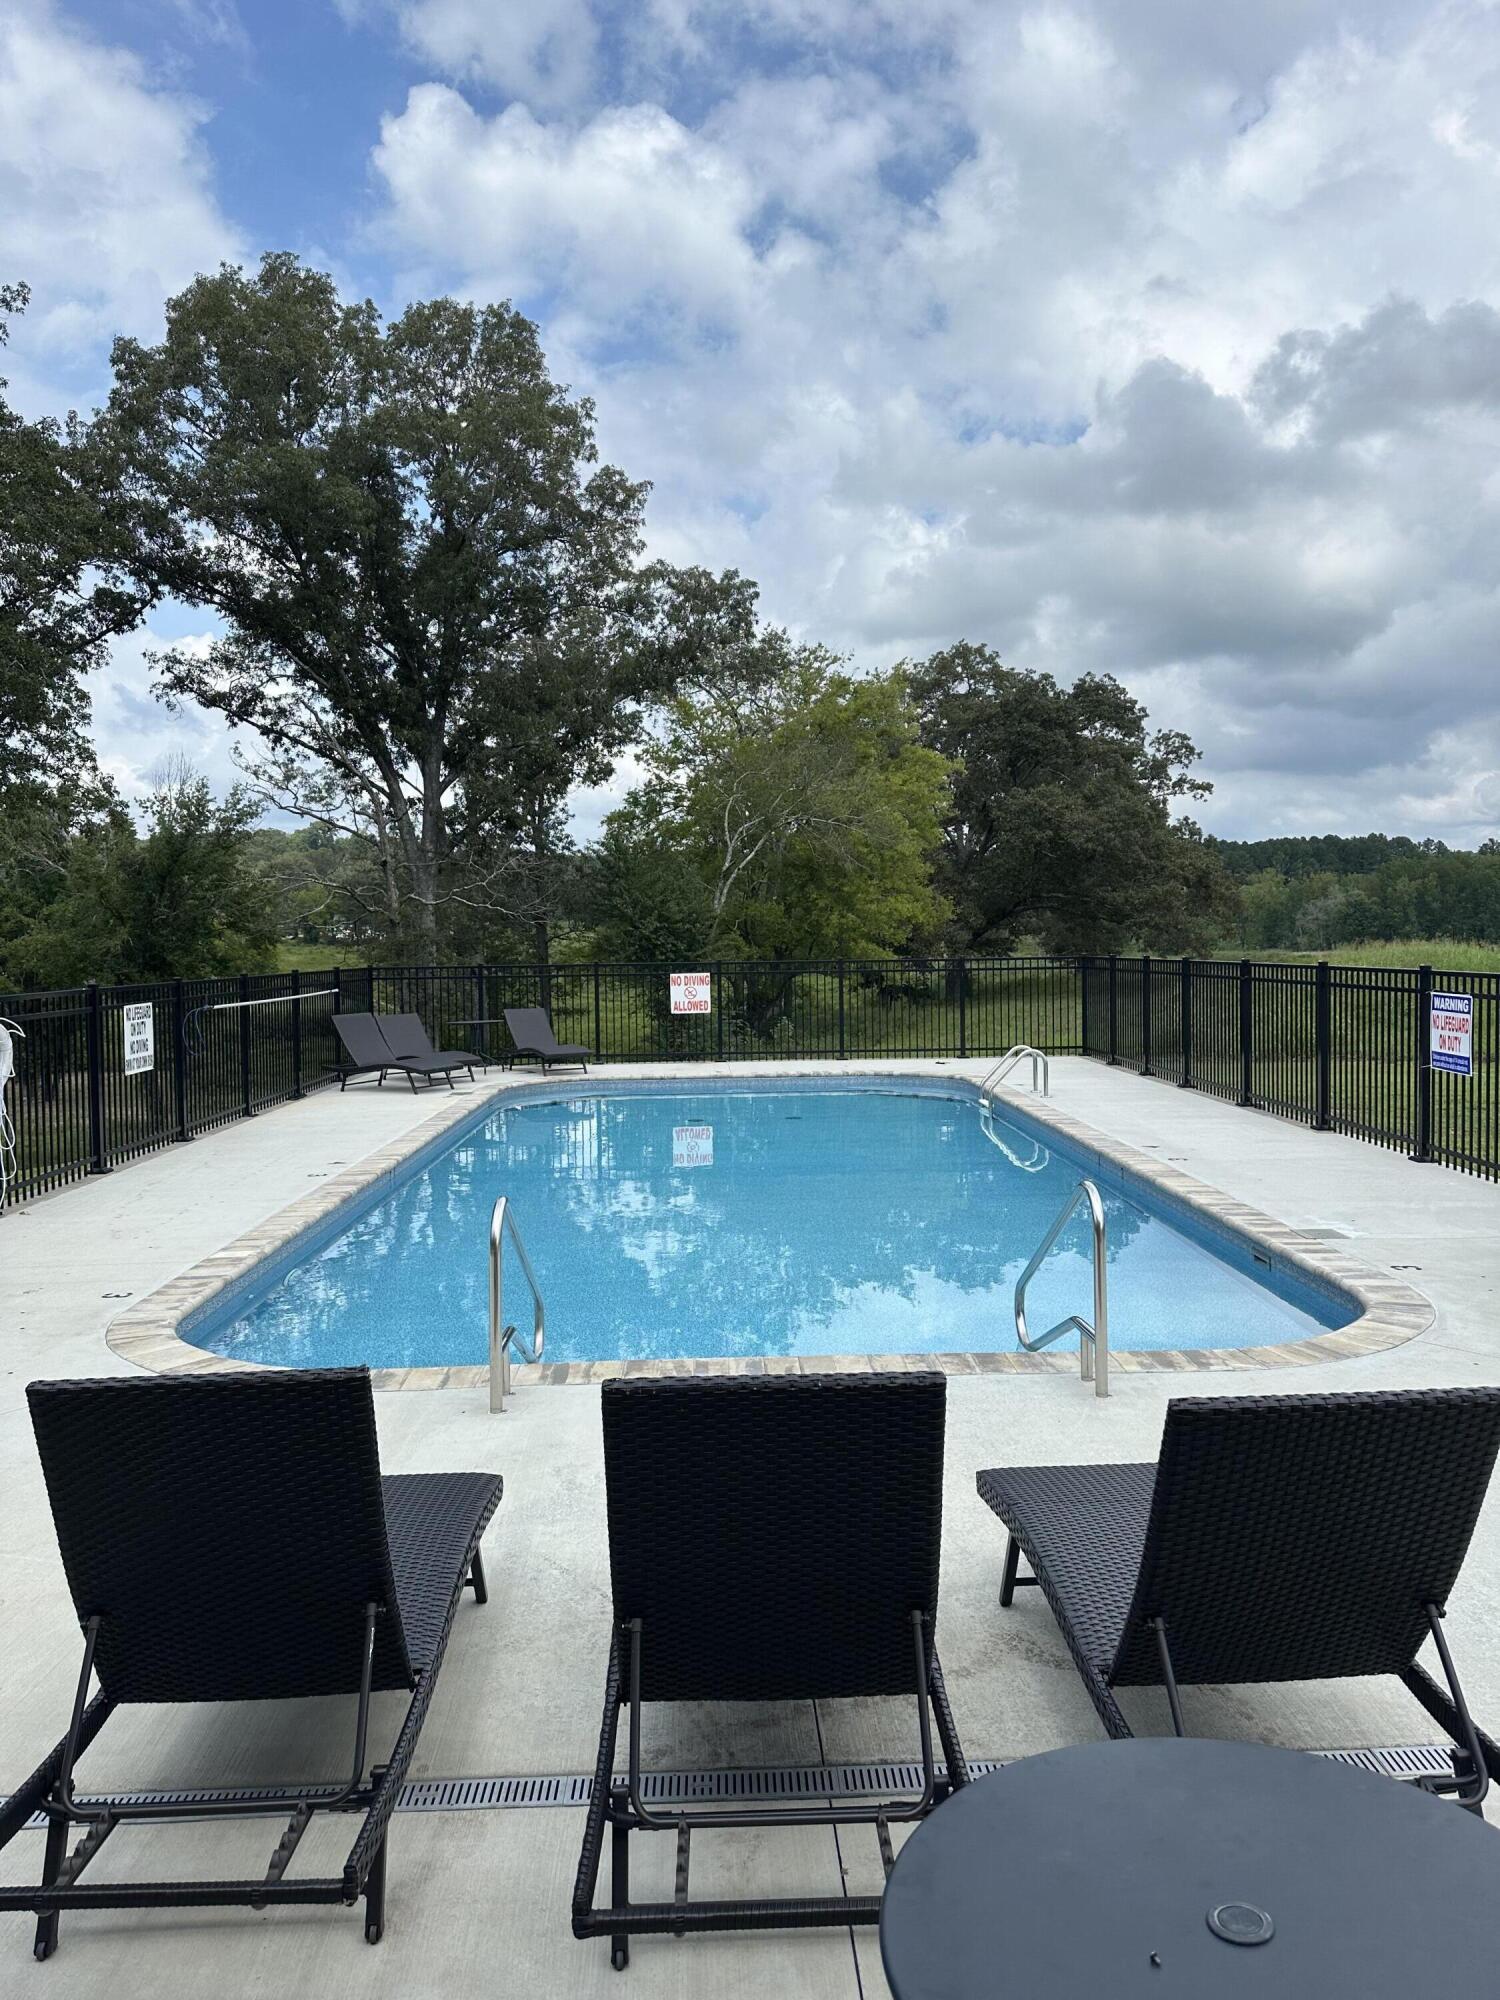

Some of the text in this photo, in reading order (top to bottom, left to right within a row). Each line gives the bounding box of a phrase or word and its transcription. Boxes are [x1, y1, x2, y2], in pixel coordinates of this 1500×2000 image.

[671, 975, 710, 987] NO DIVING
[673, 1000, 709, 1011] ALLOWED
[1434, 996, 1469, 1013] WARNING
[1432, 1014, 1469, 1034] NO LIFEGUARD
[1439, 1034, 1461, 1052] ON DUTY
